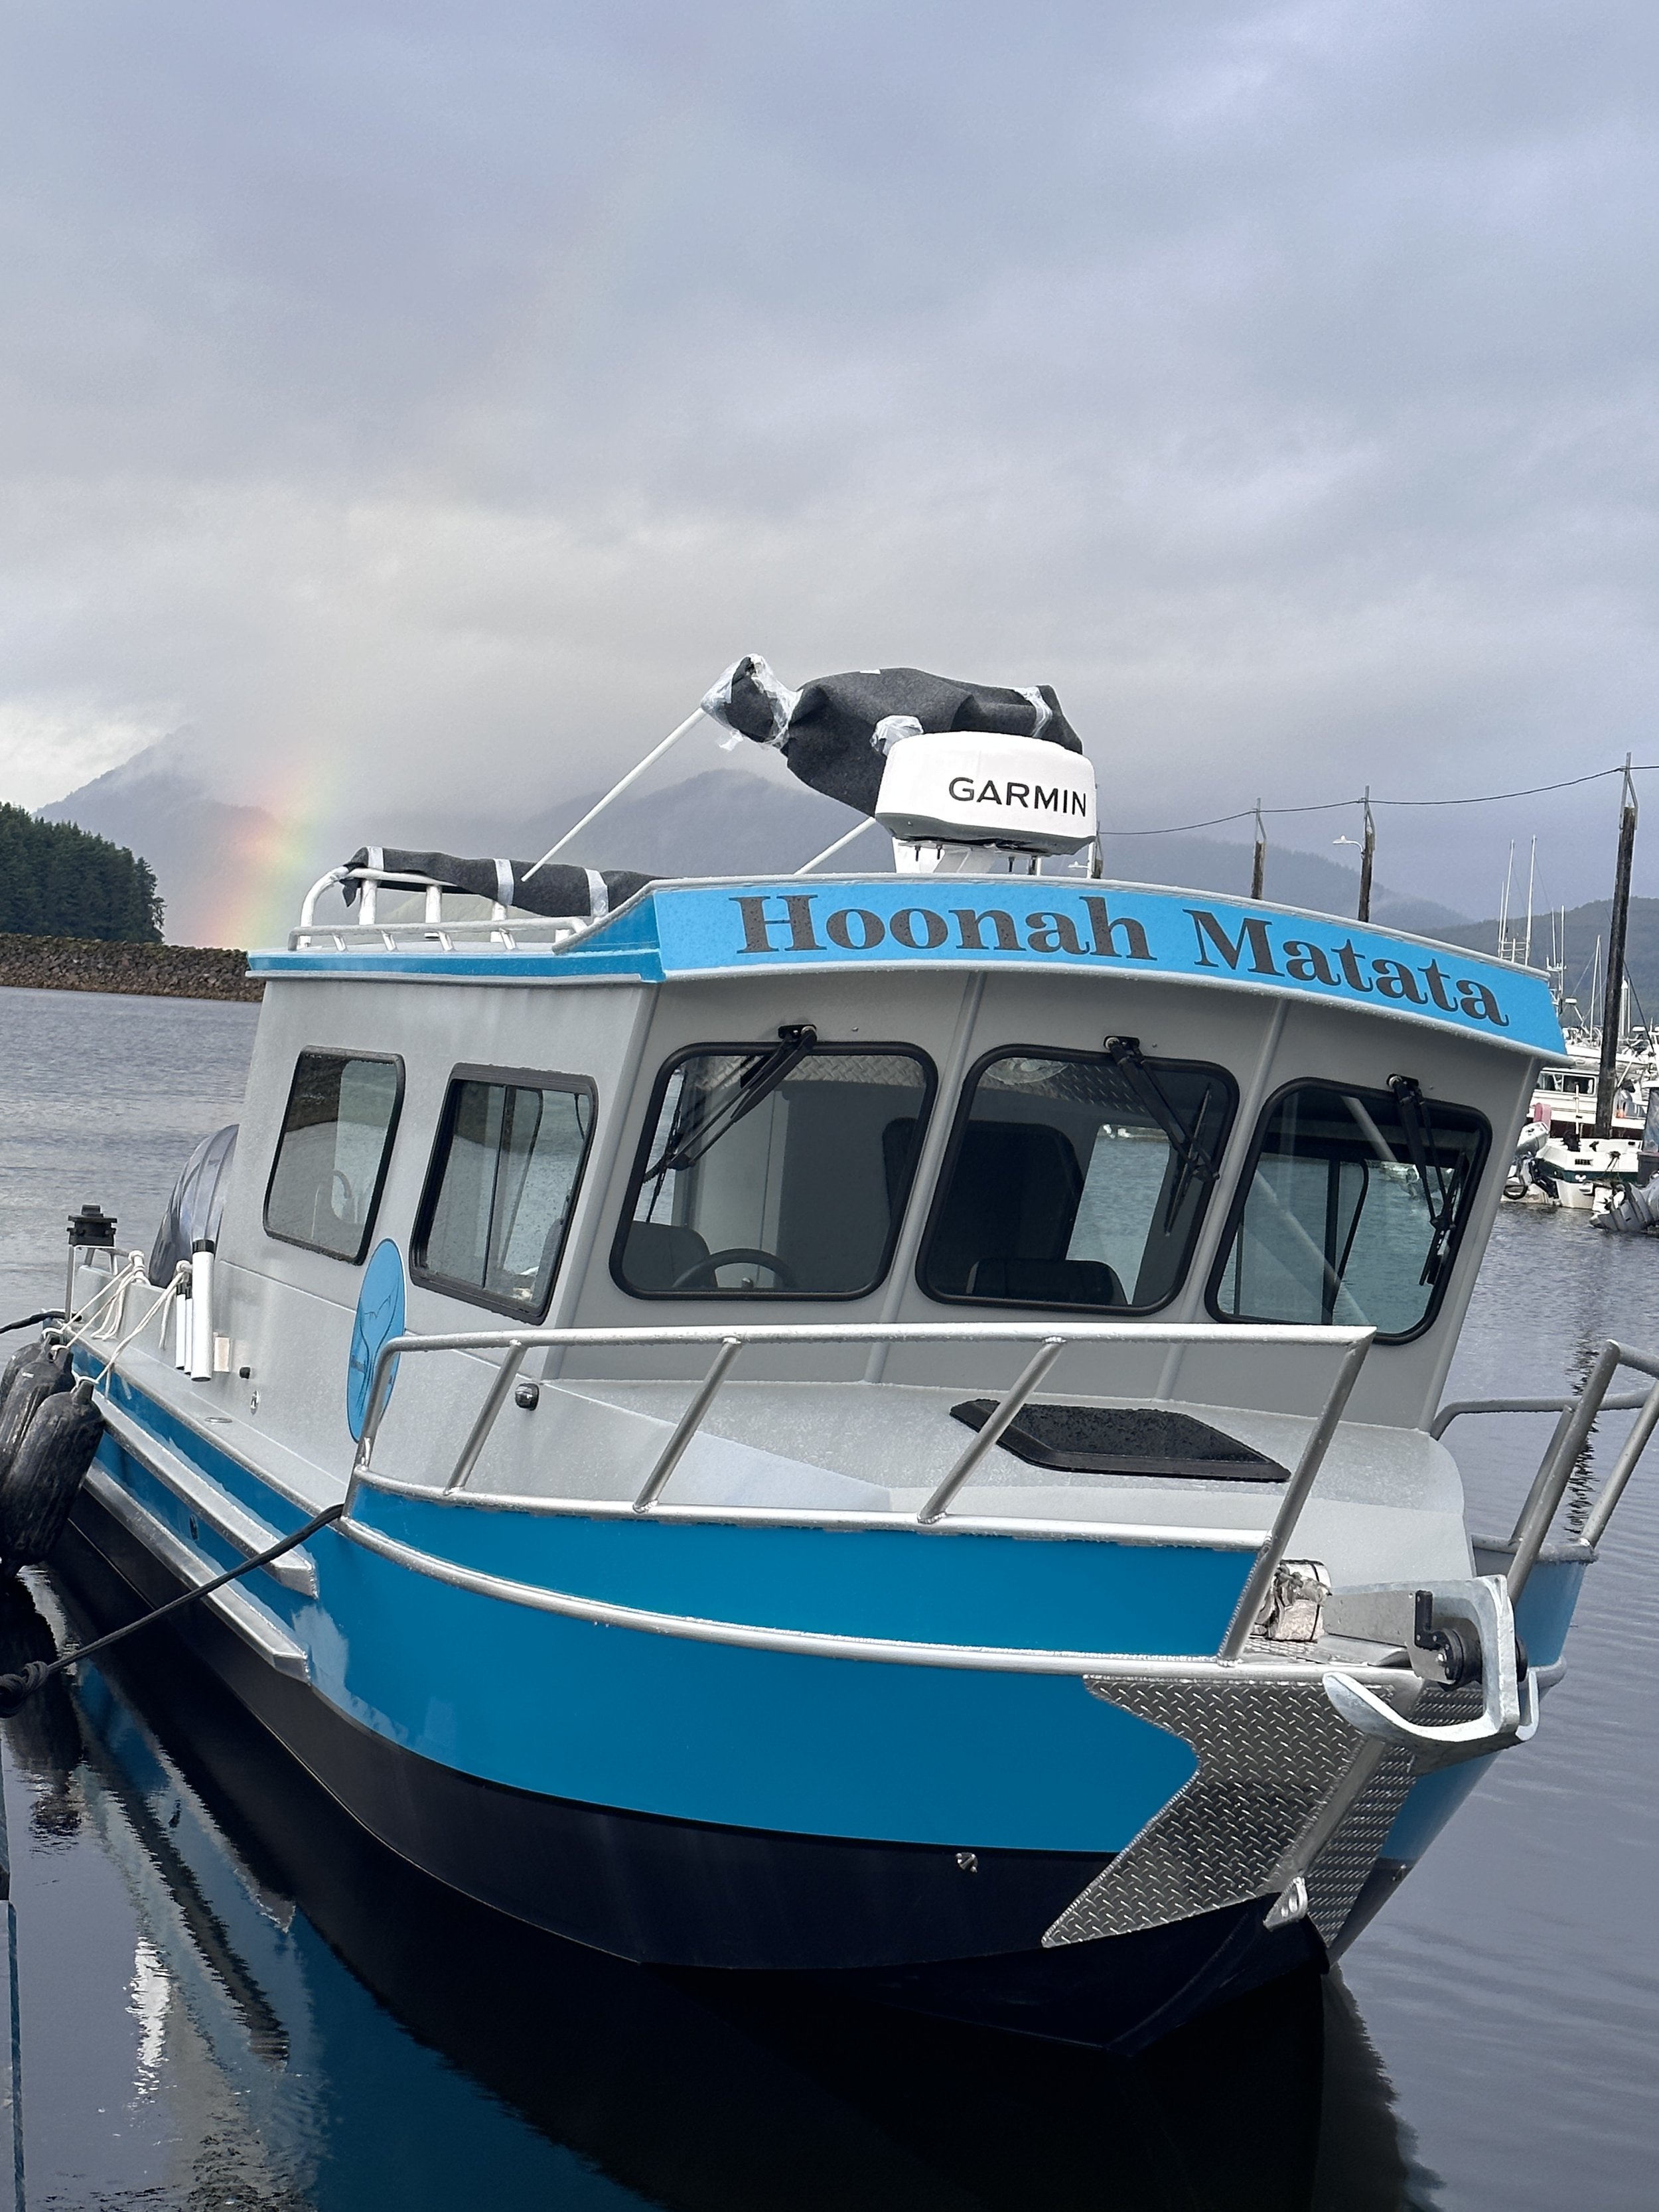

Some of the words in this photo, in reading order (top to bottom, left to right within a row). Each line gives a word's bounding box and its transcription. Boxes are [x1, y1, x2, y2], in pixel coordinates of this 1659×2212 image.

[949, 777, 1086, 817] GARMIN
[729, 894, 1157, 961] Hoonah
[1183, 908, 1510, 1027] Matata
